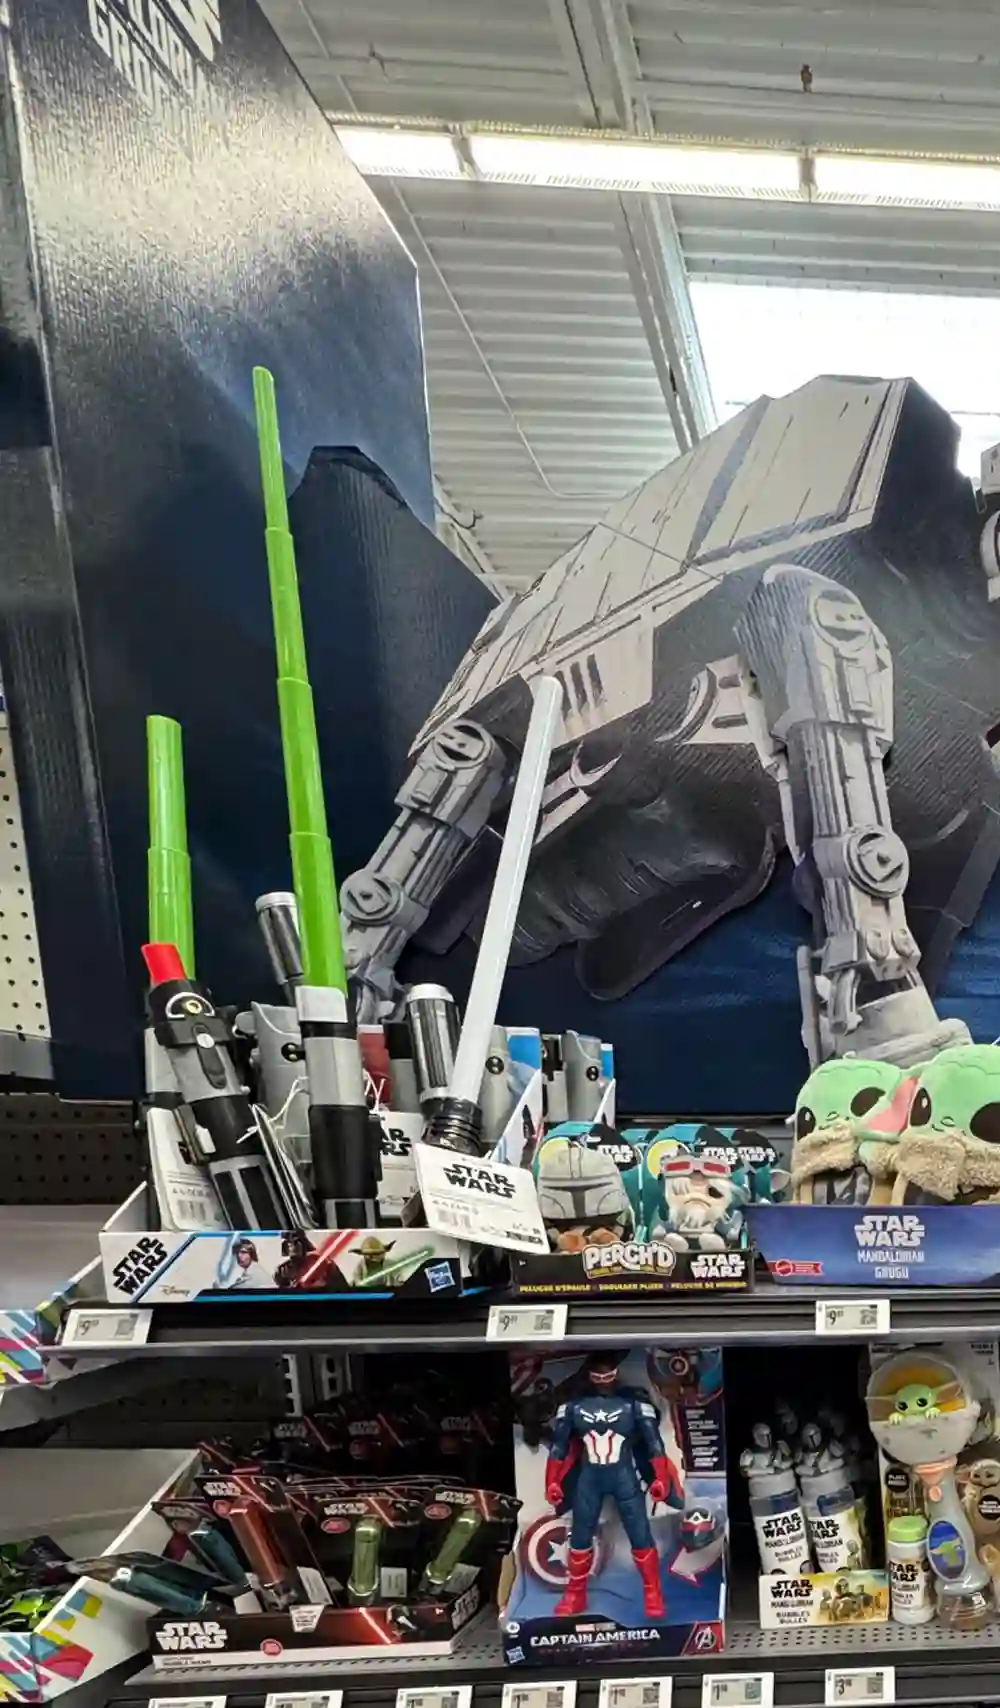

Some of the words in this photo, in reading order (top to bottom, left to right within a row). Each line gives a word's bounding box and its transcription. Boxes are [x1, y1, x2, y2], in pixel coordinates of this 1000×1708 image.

[854, 1215, 925, 1232] STAR
[855, 1230, 925, 1248] WARS
[584, 1241, 675, 1270] PERCH'D
[529, 1630, 595, 1648] CAPTAIN
[595, 1628, 661, 1644] AMERICA
